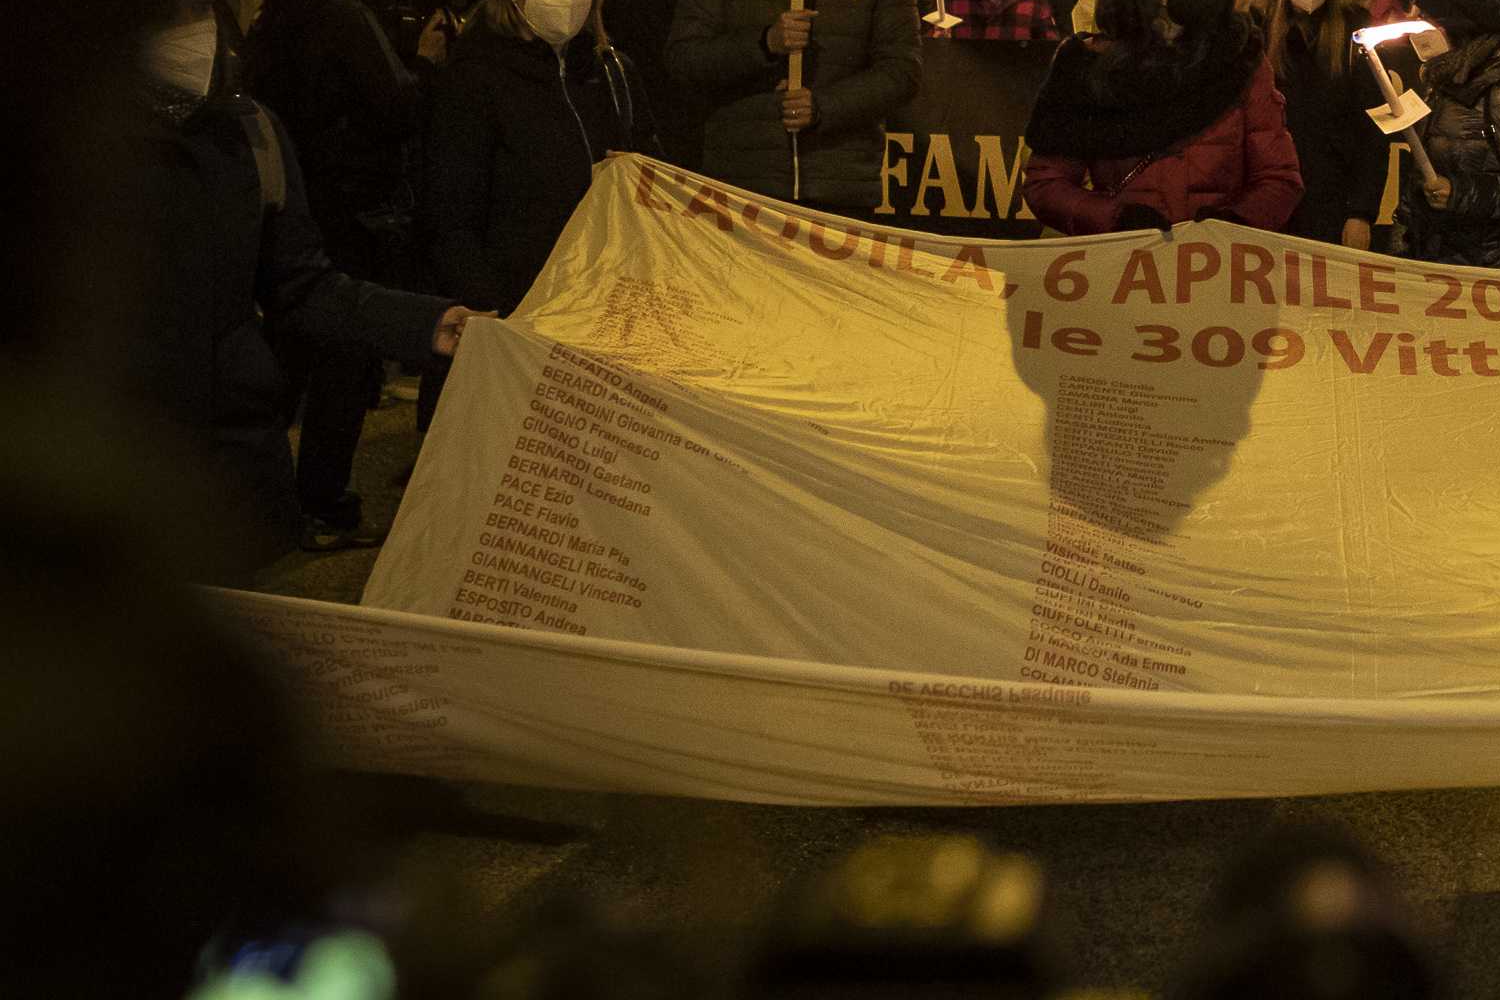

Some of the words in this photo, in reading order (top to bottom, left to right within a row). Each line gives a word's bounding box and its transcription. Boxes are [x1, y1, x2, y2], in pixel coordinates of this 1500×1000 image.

[874, 132, 1037, 219] FAM
[1044, 250, 1090, 302] 6
[1111, 242, 1400, 315] APRILE
[1022, 311, 1103, 356] le
[1131, 324, 1306, 371] 309
[542, 365, 608, 398] BERARDI
[522, 416, 580, 450] GIUGNO
[582, 441, 618, 465] Luigi
[530, 399, 587, 431] GIUGNO
[589, 424, 661, 462] Francesco
[535, 382, 616, 424] BERARDINI
[616, 414, 682, 447] Giovanna
[500, 473, 543, 498] PACE
[543, 486, 575, 506] Ezio
[507, 454, 585, 489] BERNARDI
[586, 482, 651, 517] Loredana
[514, 436, 592, 474] BERNARDI
[593, 466, 651, 495] Gaetano
[493, 493, 535, 517] PACE
[536, 506, 580, 530] Flavio
[479, 531, 583, 574] GIANNANGELI
[585, 560, 648, 593] Riccardo
[485, 512, 566, 549] BERNARDI
[566, 535, 606, 557] Maria
[607, 547, 631, 567] Pia
[1102, 552, 1147, 577] Matteo
[463, 568, 511, 594] BERTI
[512, 580, 579, 614] Valentina
[471, 550, 577, 593] GIANNANGELI
[578, 581, 643, 609] Vincenzo
[1040, 560, 1088, 588] CIOLLI
[1089, 577, 1131, 603] Danilo
[455, 587, 534, 619] ESPOSITO
[533, 610, 588, 636] Andrea
[1023, 646, 1041, 663] DI
[1042, 650, 1100, 679] MARCO
[1102, 667, 1161, 692] Stefania
[1142, 657, 1188, 676] Emma
